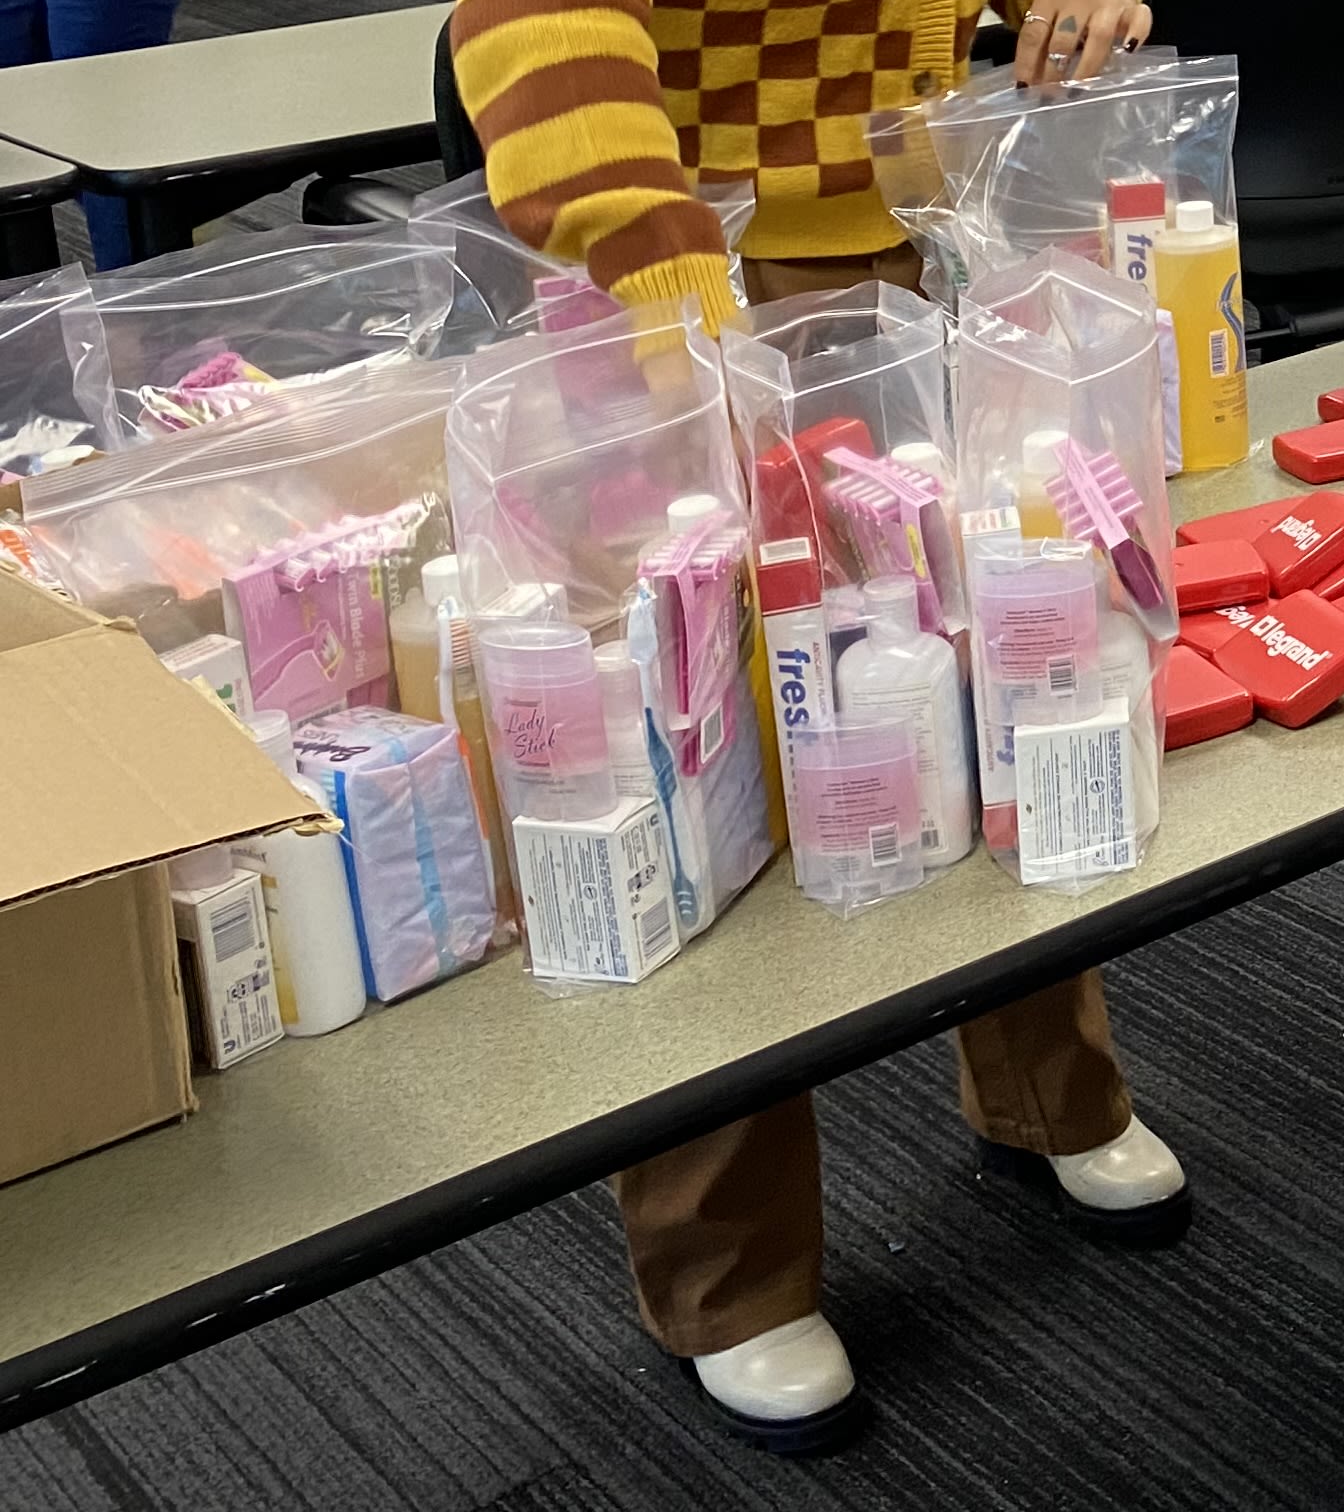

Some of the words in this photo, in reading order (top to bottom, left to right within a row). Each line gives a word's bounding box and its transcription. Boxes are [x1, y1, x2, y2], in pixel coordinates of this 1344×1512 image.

[350, 607, 366, 649] Blade
[1261, 622, 1330, 671] legrand
[504, 709, 544, 735] Lady
[514, 729, 555, 758] Stick
